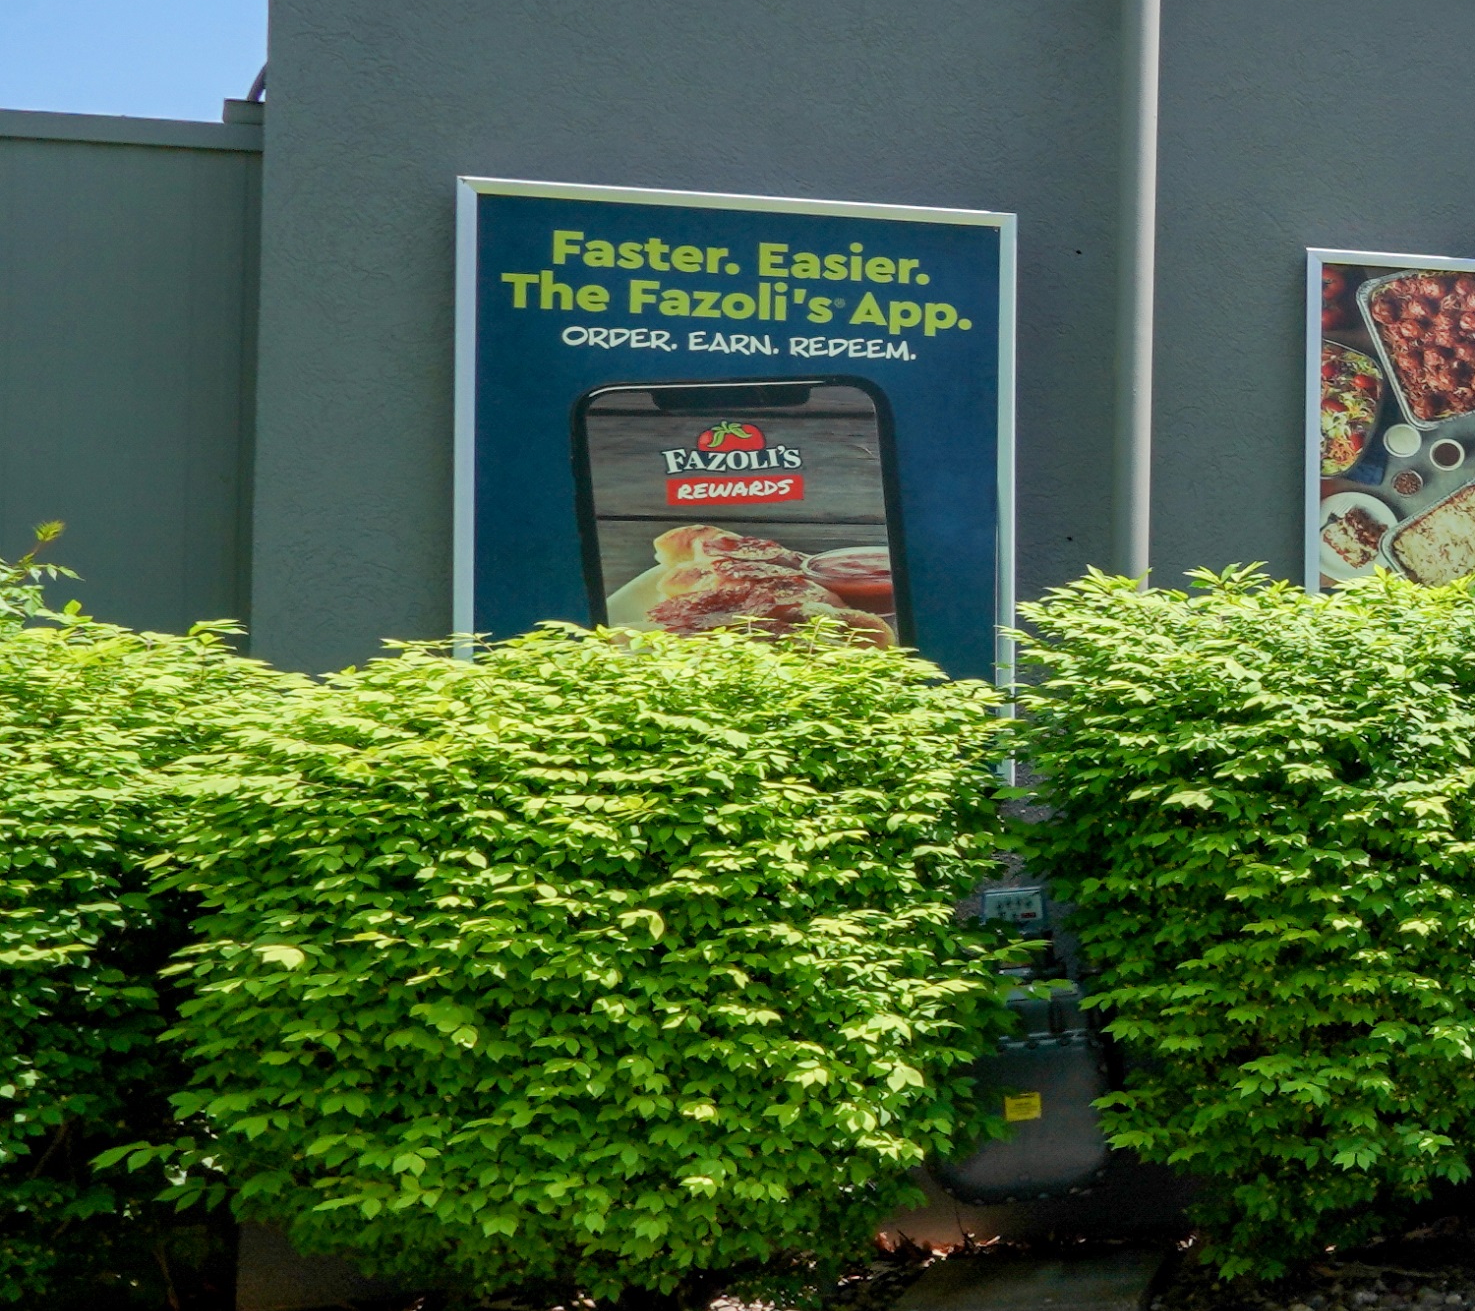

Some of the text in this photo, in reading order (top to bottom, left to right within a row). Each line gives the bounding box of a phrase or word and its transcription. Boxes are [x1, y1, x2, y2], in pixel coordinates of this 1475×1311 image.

[553, 230, 931, 285] Faster. Easier.
[501, 270, 610, 312] The
[848, 291, 973, 337] App.
[561, 326, 917, 362] ORDER. EARN. REDEEM.
[661, 445, 803, 474] FAZOLI'S
[677, 478, 794, 500] REWARDS
